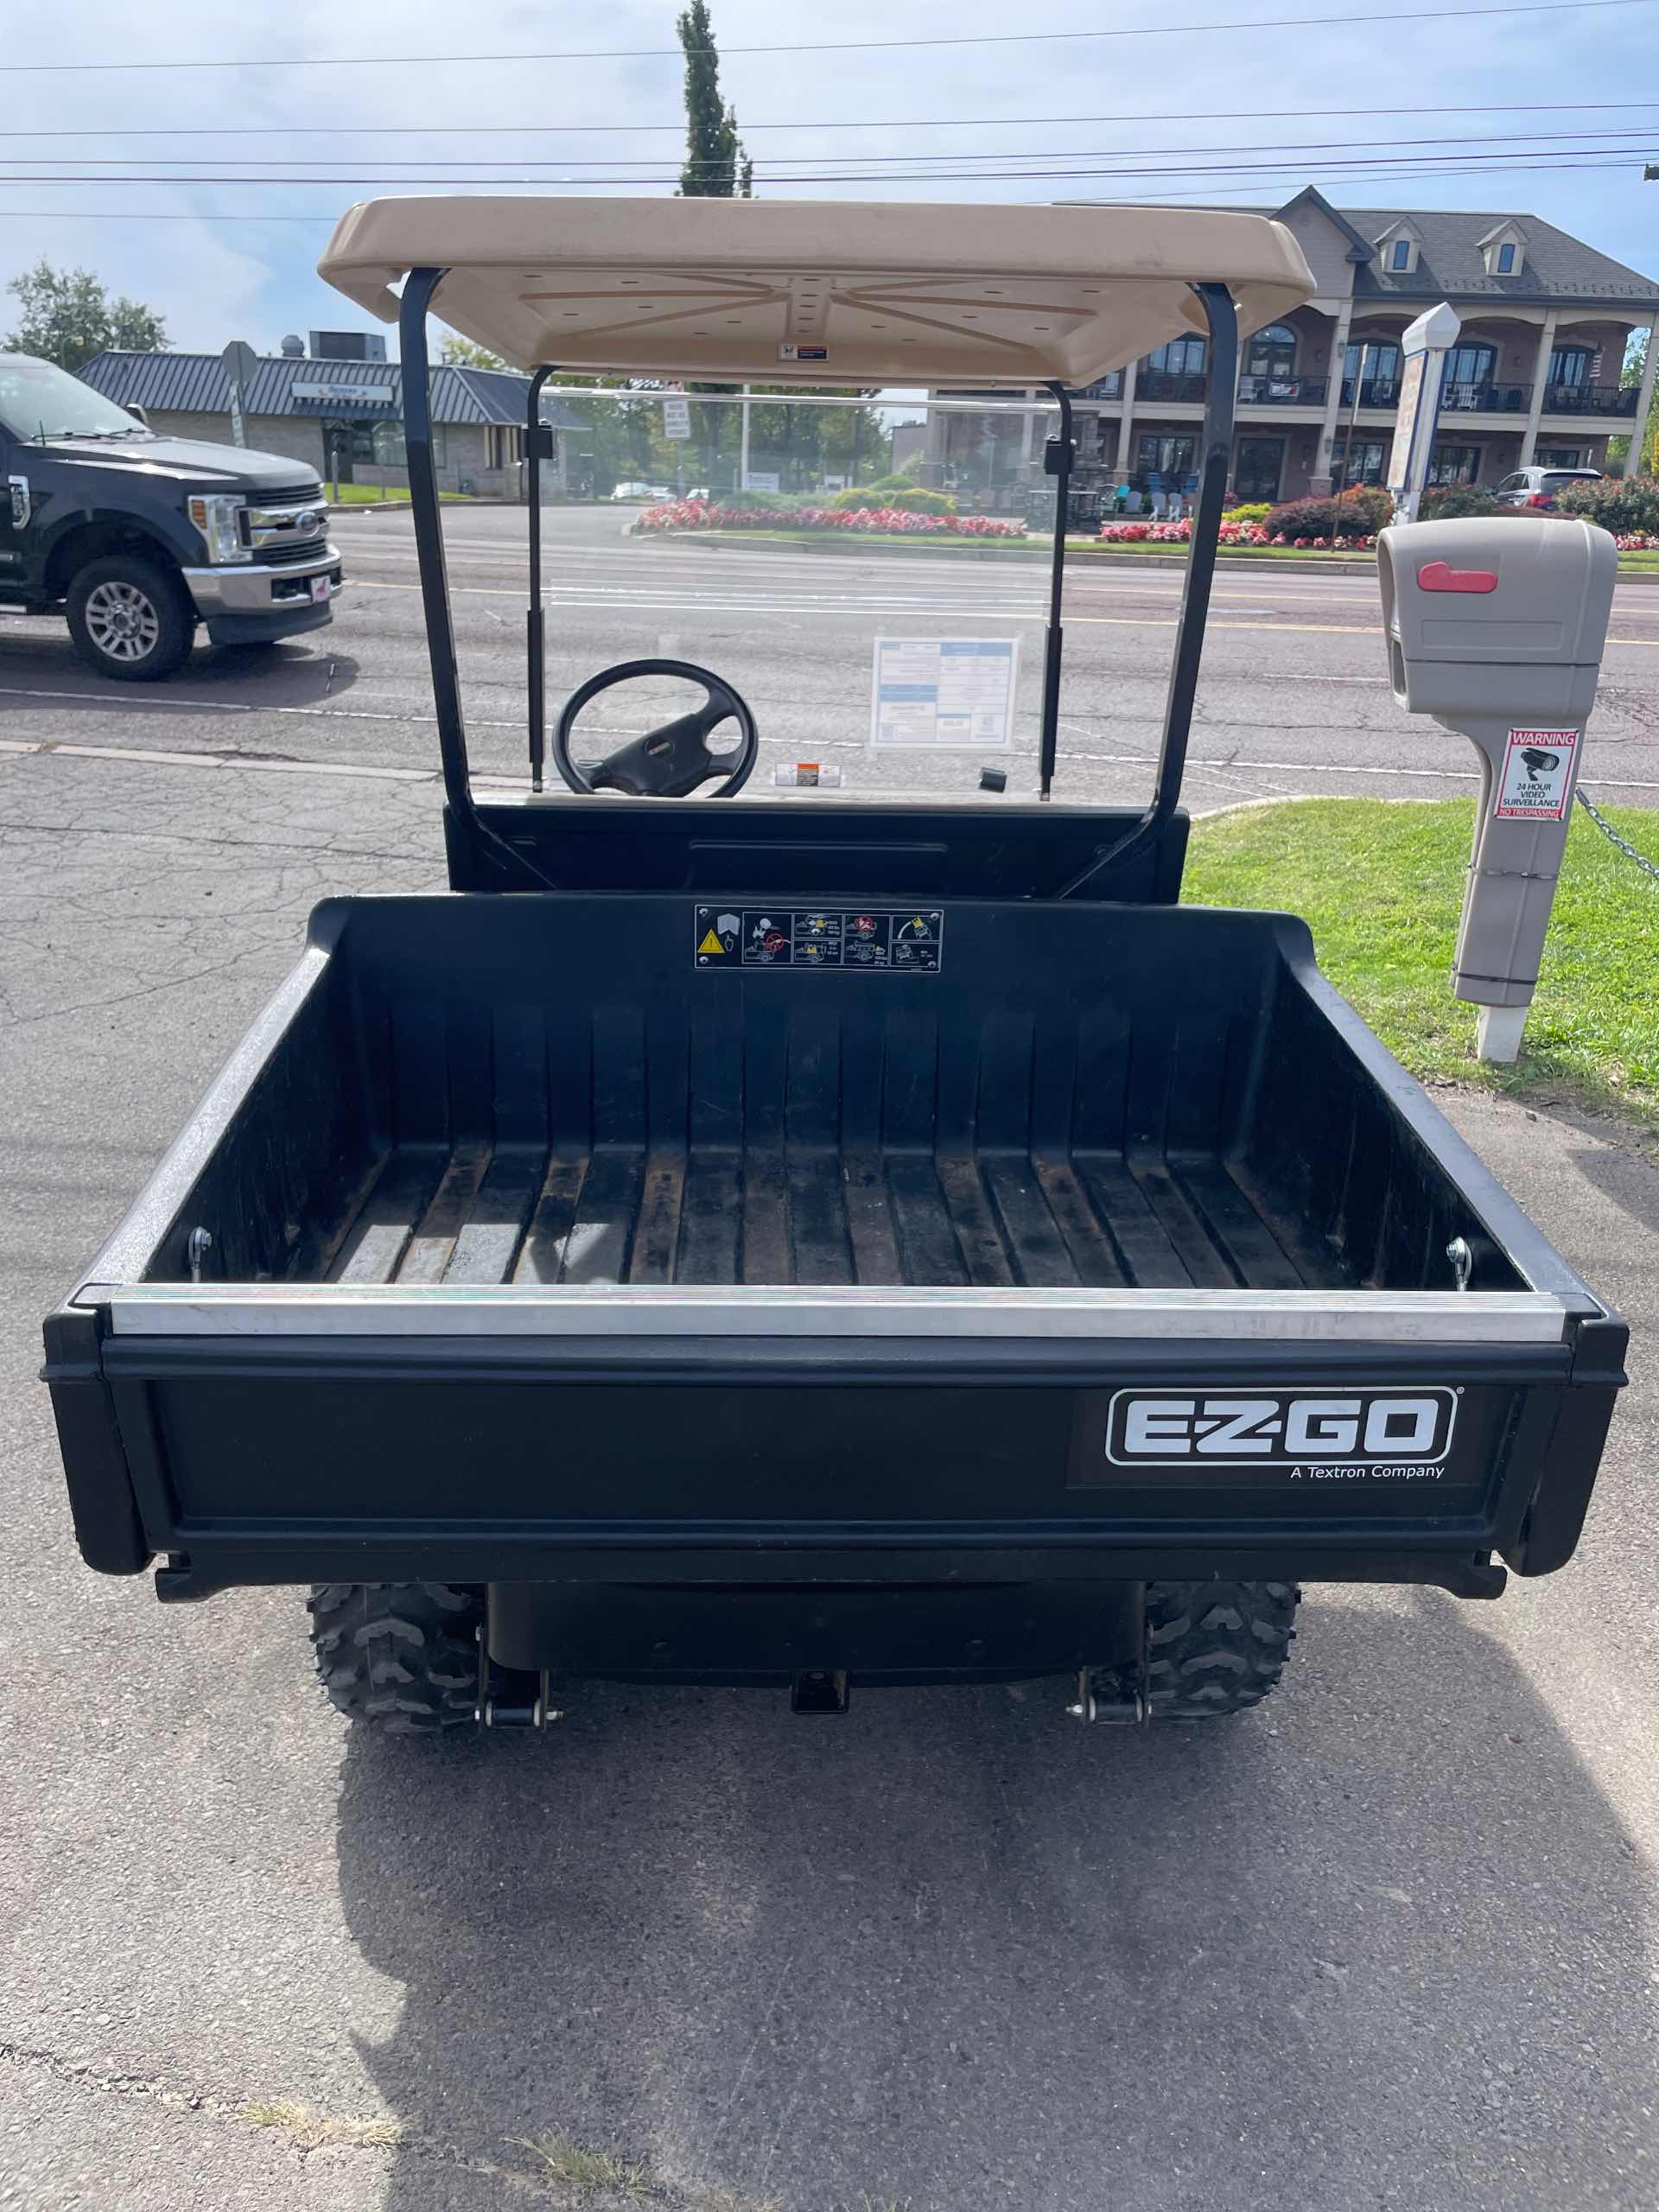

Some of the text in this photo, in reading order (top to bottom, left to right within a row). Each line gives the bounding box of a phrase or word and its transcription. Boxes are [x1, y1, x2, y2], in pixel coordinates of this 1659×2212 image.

[1512, 732, 1575, 745] WARNING
[1528, 783, 1552, 791] HOUR
[1520, 791, 1546, 799] VIDEO
[1503, 798, 1560, 808] SURVEILLANCE
[1499, 807, 1560, 818] NO TRESPASSING
[1290, 1465, 1446, 1480] A Textron Company
